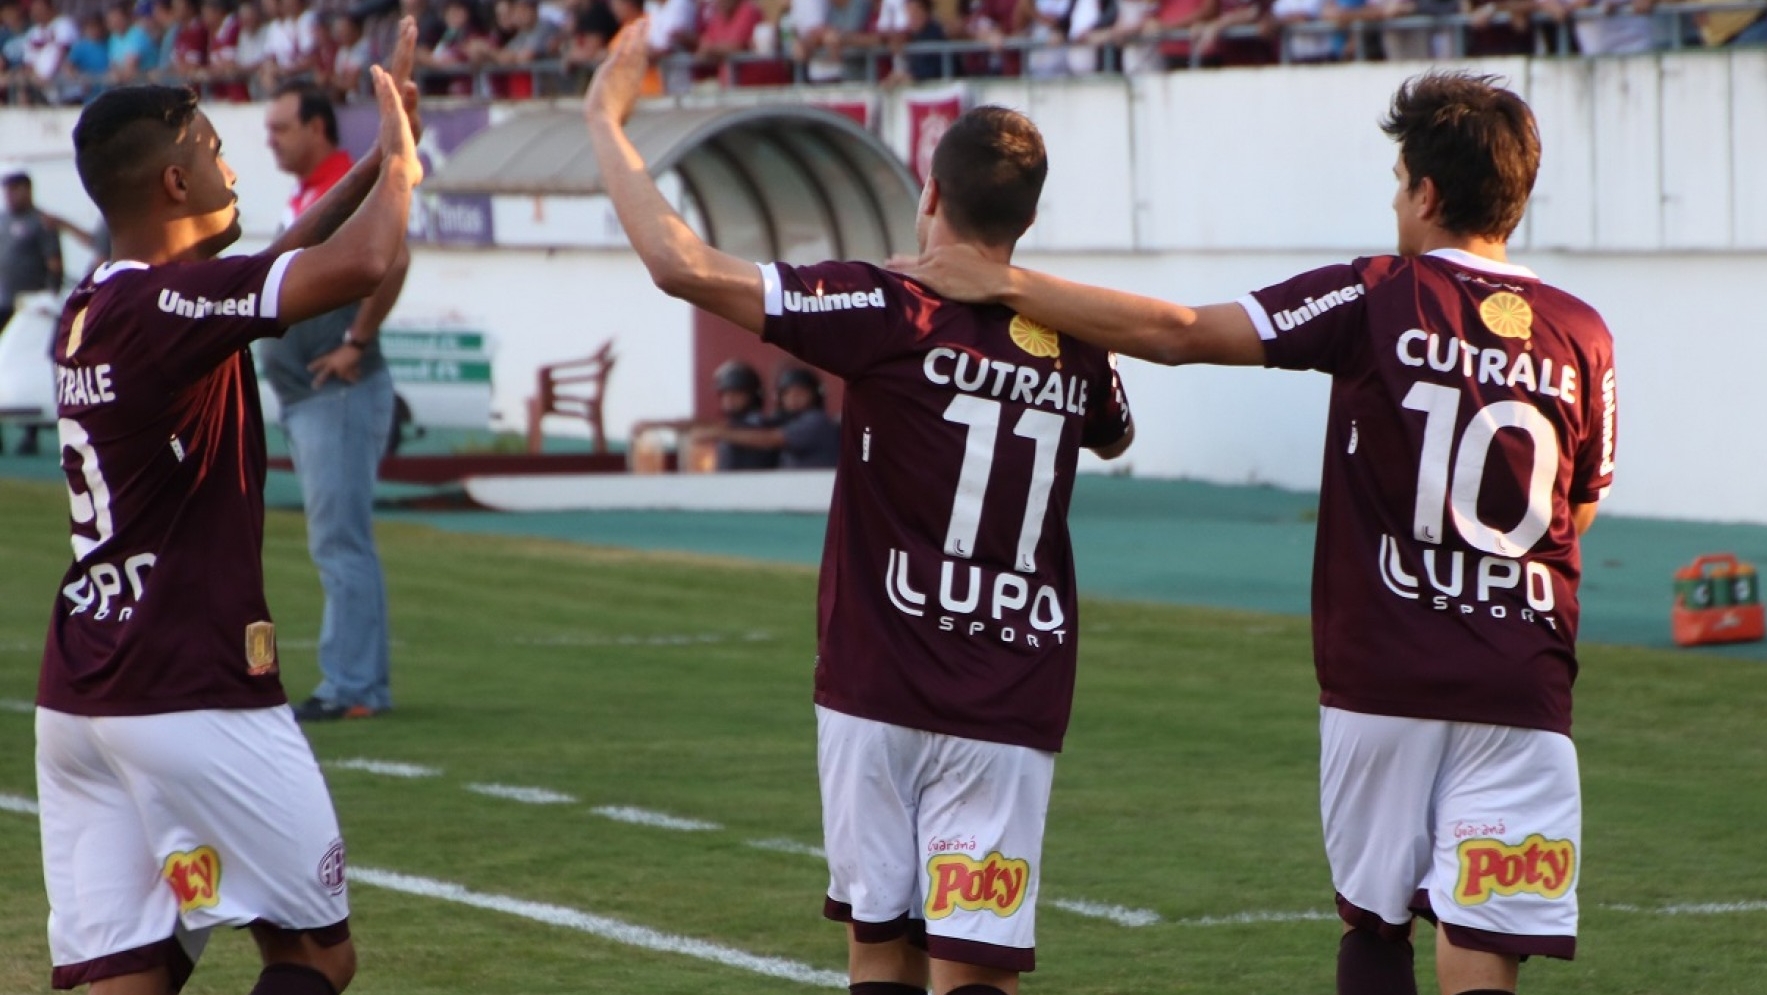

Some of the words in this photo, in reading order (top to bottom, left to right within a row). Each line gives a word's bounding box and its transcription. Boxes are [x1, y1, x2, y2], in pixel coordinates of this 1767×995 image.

[783, 288, 886, 314] Unimed
[56, 364, 116, 405] TRALE
[923, 347, 1088, 416] CUTRALE
[1396, 328, 1577, 404] CUTRALE
[58, 417, 113, 562] 9
[942, 393, 1067, 574] 11
[1401, 380, 1560, 558] 10
[885, 548, 1065, 632] LUPO
[1379, 533, 1556, 613] LUPO
[938, 615, 1067, 648] SPORT
[1432, 595, 1557, 630] SPORT
[931, 860, 1023, 911] Poty
[1463, 843, 1569, 896] Poty
